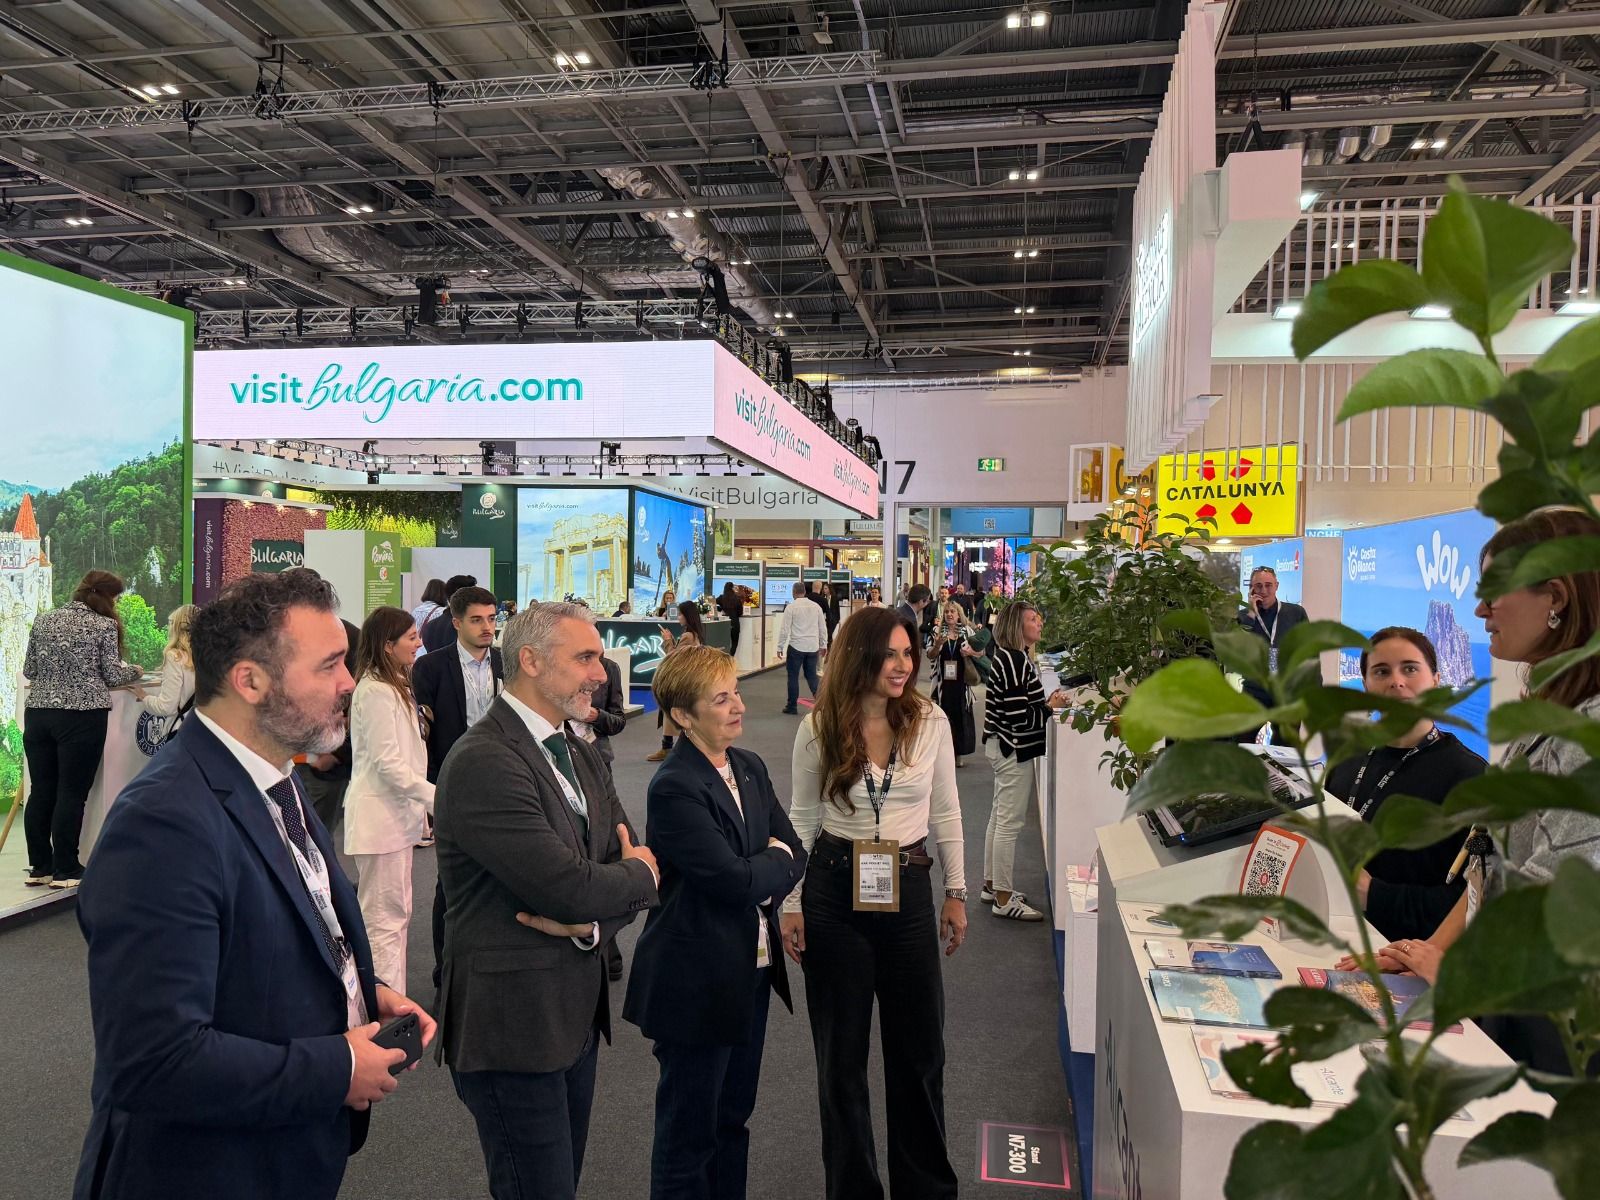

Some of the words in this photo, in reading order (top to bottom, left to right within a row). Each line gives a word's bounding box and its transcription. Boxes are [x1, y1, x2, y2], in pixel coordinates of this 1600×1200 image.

[1166, 481, 1285, 502] CATALUNYA
[1416, 530, 1471, 600] WOW
[1008, 1133, 1027, 1174] N7-300
[1030, 1146, 1042, 1165] Stand
